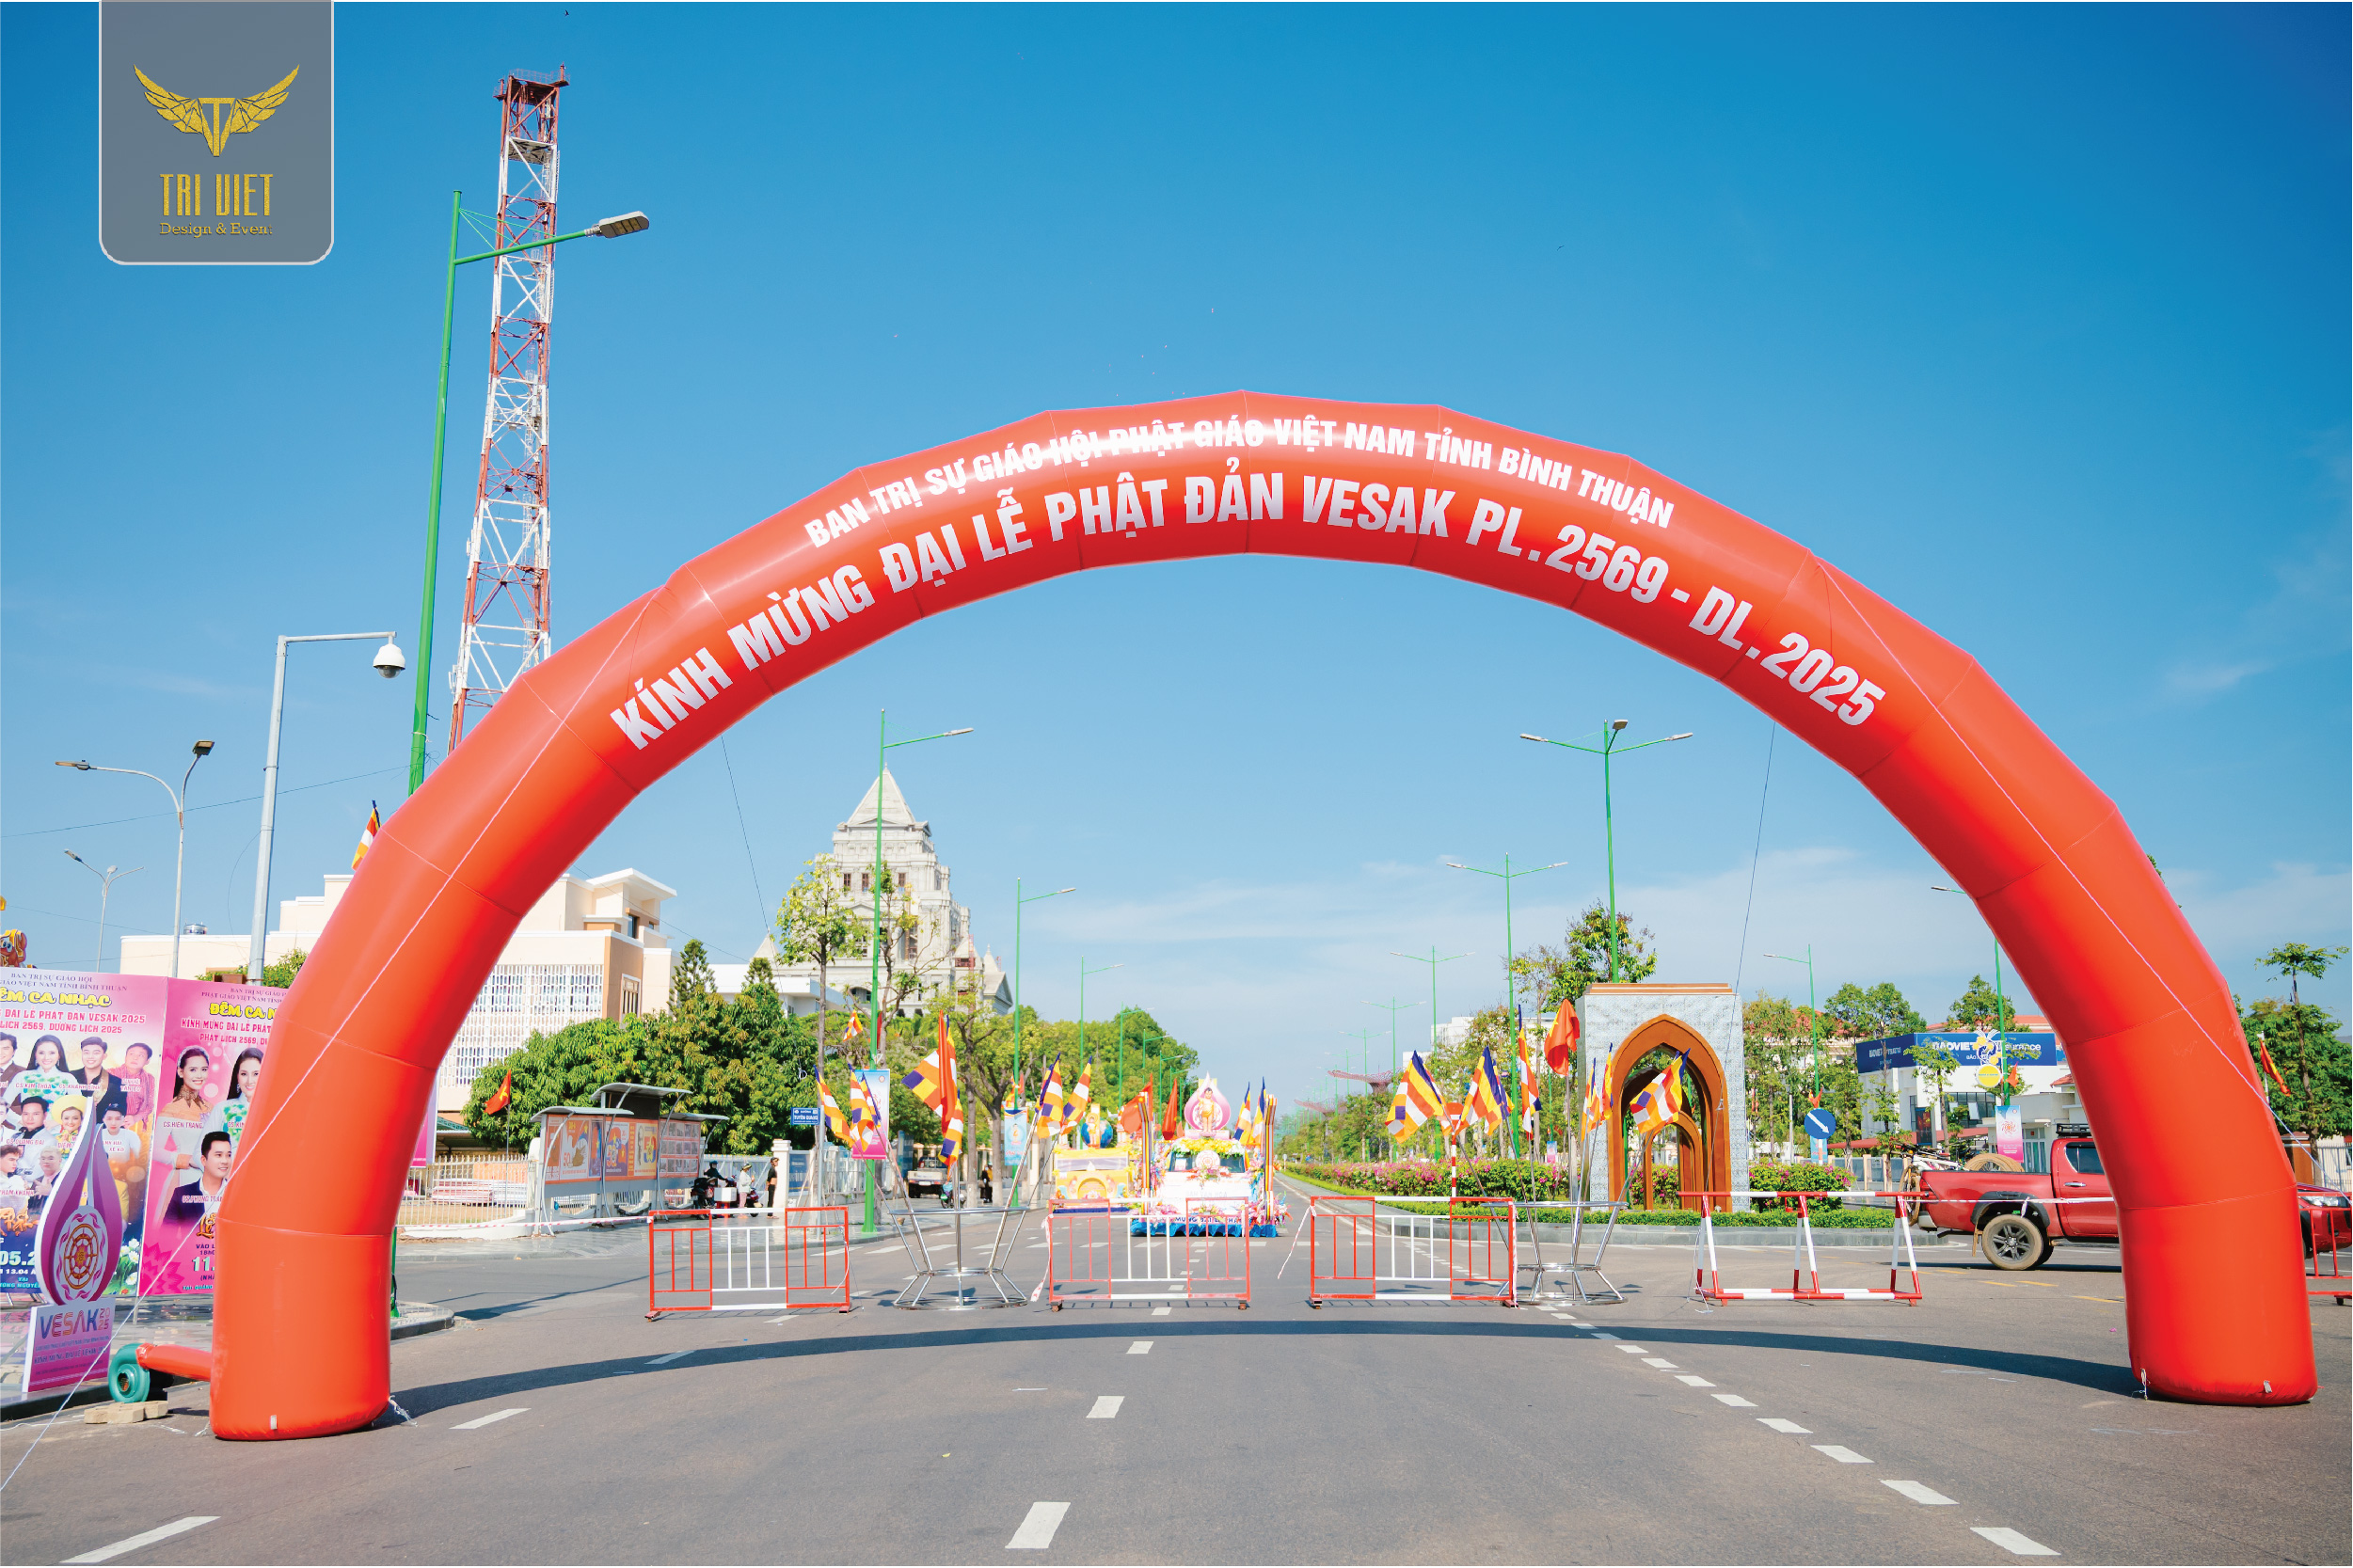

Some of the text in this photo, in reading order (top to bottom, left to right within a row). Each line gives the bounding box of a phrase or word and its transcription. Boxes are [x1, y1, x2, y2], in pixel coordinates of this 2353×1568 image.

[804, 415, 1674, 547] BAN TRỊ SỰ GIÁO HỘI PHẬT GIÁO VIỆT NAM TỈNH BÌNH THUẬN
[610, 647, 733, 751] KÍNH
[726, 564, 876, 672] MỪNG
[879, 523, 967, 594] ĐẠI
[973, 488, 1033, 562] LỄ
[1044, 472, 1169, 542] PHẬT
[1184, 456, 1283, 524] ĐẢN
[1303, 475, 1456, 538] VESAK
[28, 991, 56, 1004] CA
[59, 992, 113, 1009] NHẠC
[209, 1000, 243, 1018] ĐÊM
[245, 1006, 266, 1020] CA
[88, 1012, 119, 1022] VESAK
[121, 1014, 146, 1024] 2025
[79, 1024, 99, 1034] LỊCH
[101, 1025, 122, 1034] 2025
[40, 1308, 99, 1339] VESAK
